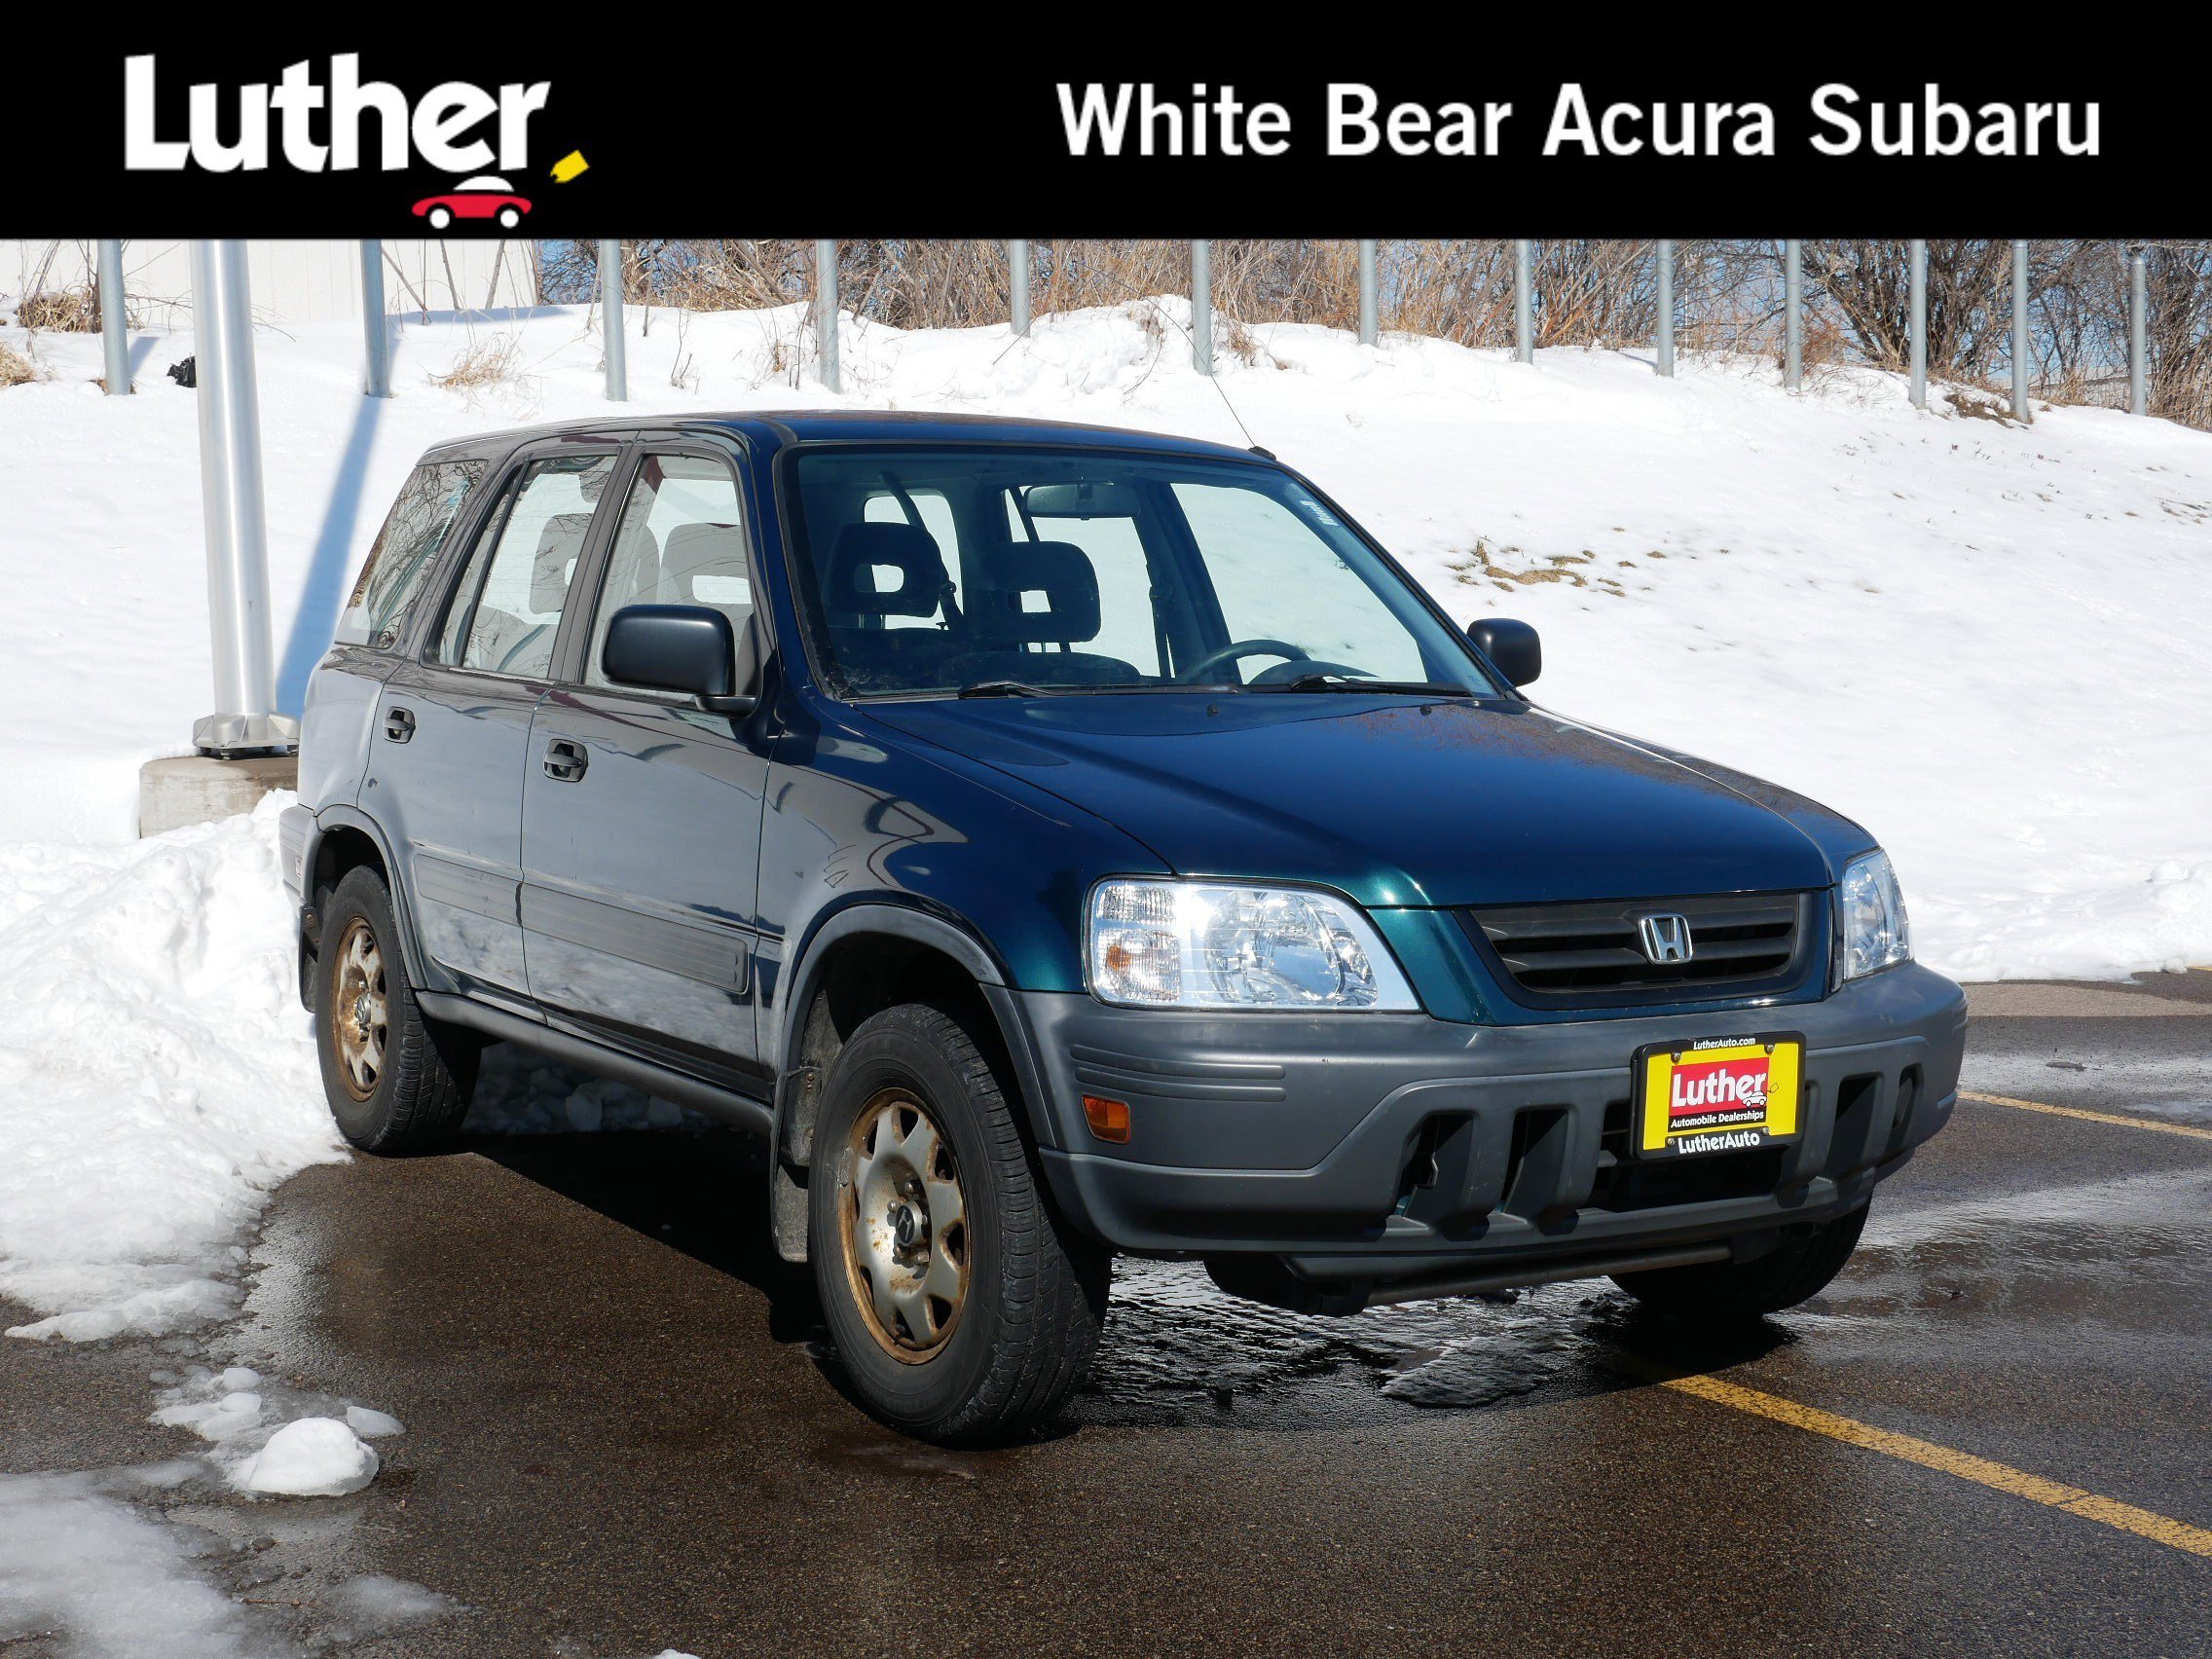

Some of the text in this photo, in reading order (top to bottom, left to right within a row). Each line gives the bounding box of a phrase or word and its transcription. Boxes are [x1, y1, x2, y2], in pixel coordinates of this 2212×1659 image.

[1693, 1037, 1756, 1051] LutherAuto.com
[1672, 1068, 1767, 1108] Luther
[1670, 1110, 1764, 1128] Automobile Dealerships
[1677, 1130, 1760, 1155] LutherAuto
